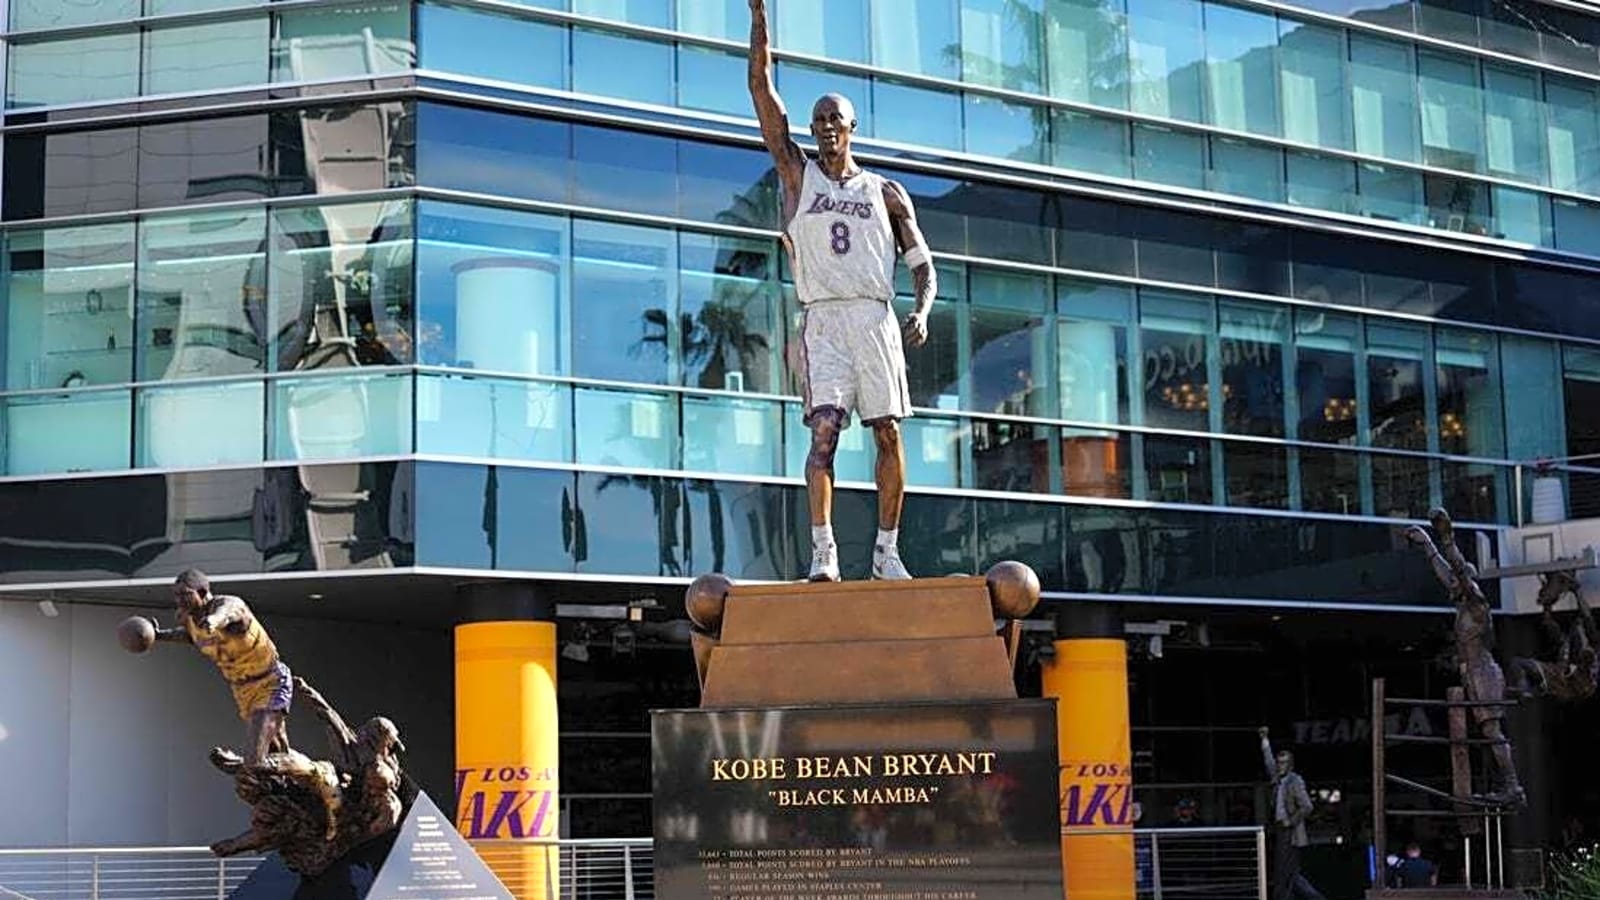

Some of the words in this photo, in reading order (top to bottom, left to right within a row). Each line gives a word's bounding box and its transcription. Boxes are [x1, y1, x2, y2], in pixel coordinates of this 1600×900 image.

[806, 192, 873, 219] LAKERS
[831, 221, 850, 255] 8
[712, 758, 785, 780] KOBE
[796, 756, 872, 778] BEAN
[884, 752, 996, 777] BRYANT
[1077, 763, 1118, 777] LOS
[481, 766, 532, 782] LOS
[839, 859, 873, 867] BRYANT
[888, 858, 904, 866] THE
[929, 857, 971, 865] PLAYOFFS
[773, 872, 804, 880] SEASON
[808, 871, 829, 879] WINS
[811, 883, 845, 891] STAPLES
[847, 882, 881, 890] CENTER
